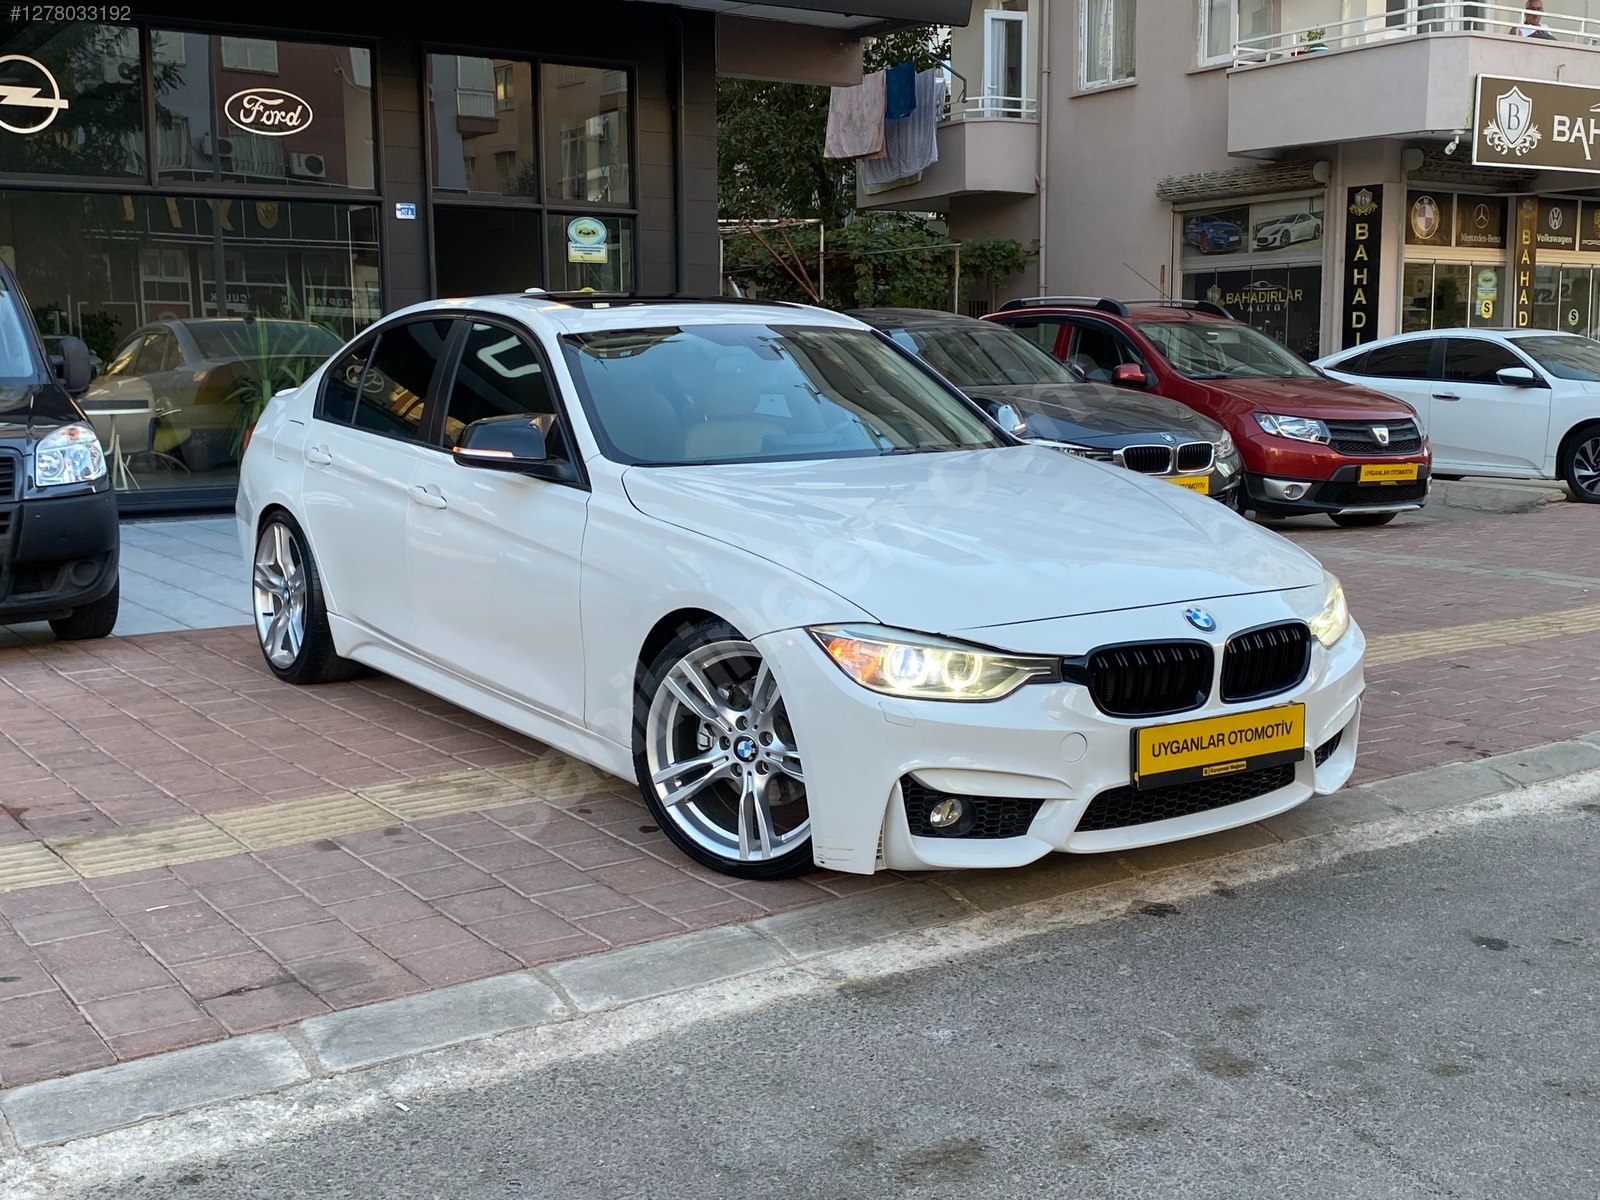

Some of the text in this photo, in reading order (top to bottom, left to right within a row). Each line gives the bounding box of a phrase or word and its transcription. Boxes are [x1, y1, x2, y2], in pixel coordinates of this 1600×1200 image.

[239, 94, 303, 128] Ford
[1507, 103, 1521, 131] B
[1460, 232, 1502, 243] Mercedes-Benz
[1536, 233, 1573, 245] Volkswagen
[1226, 288, 1304, 311] BAHADIRLAR
[1247, 303, 1281, 313] AUTO
[1570, 310, 1577, 321] S
[1152, 719, 1294, 758] UYGANLAR OTOMOTİV
